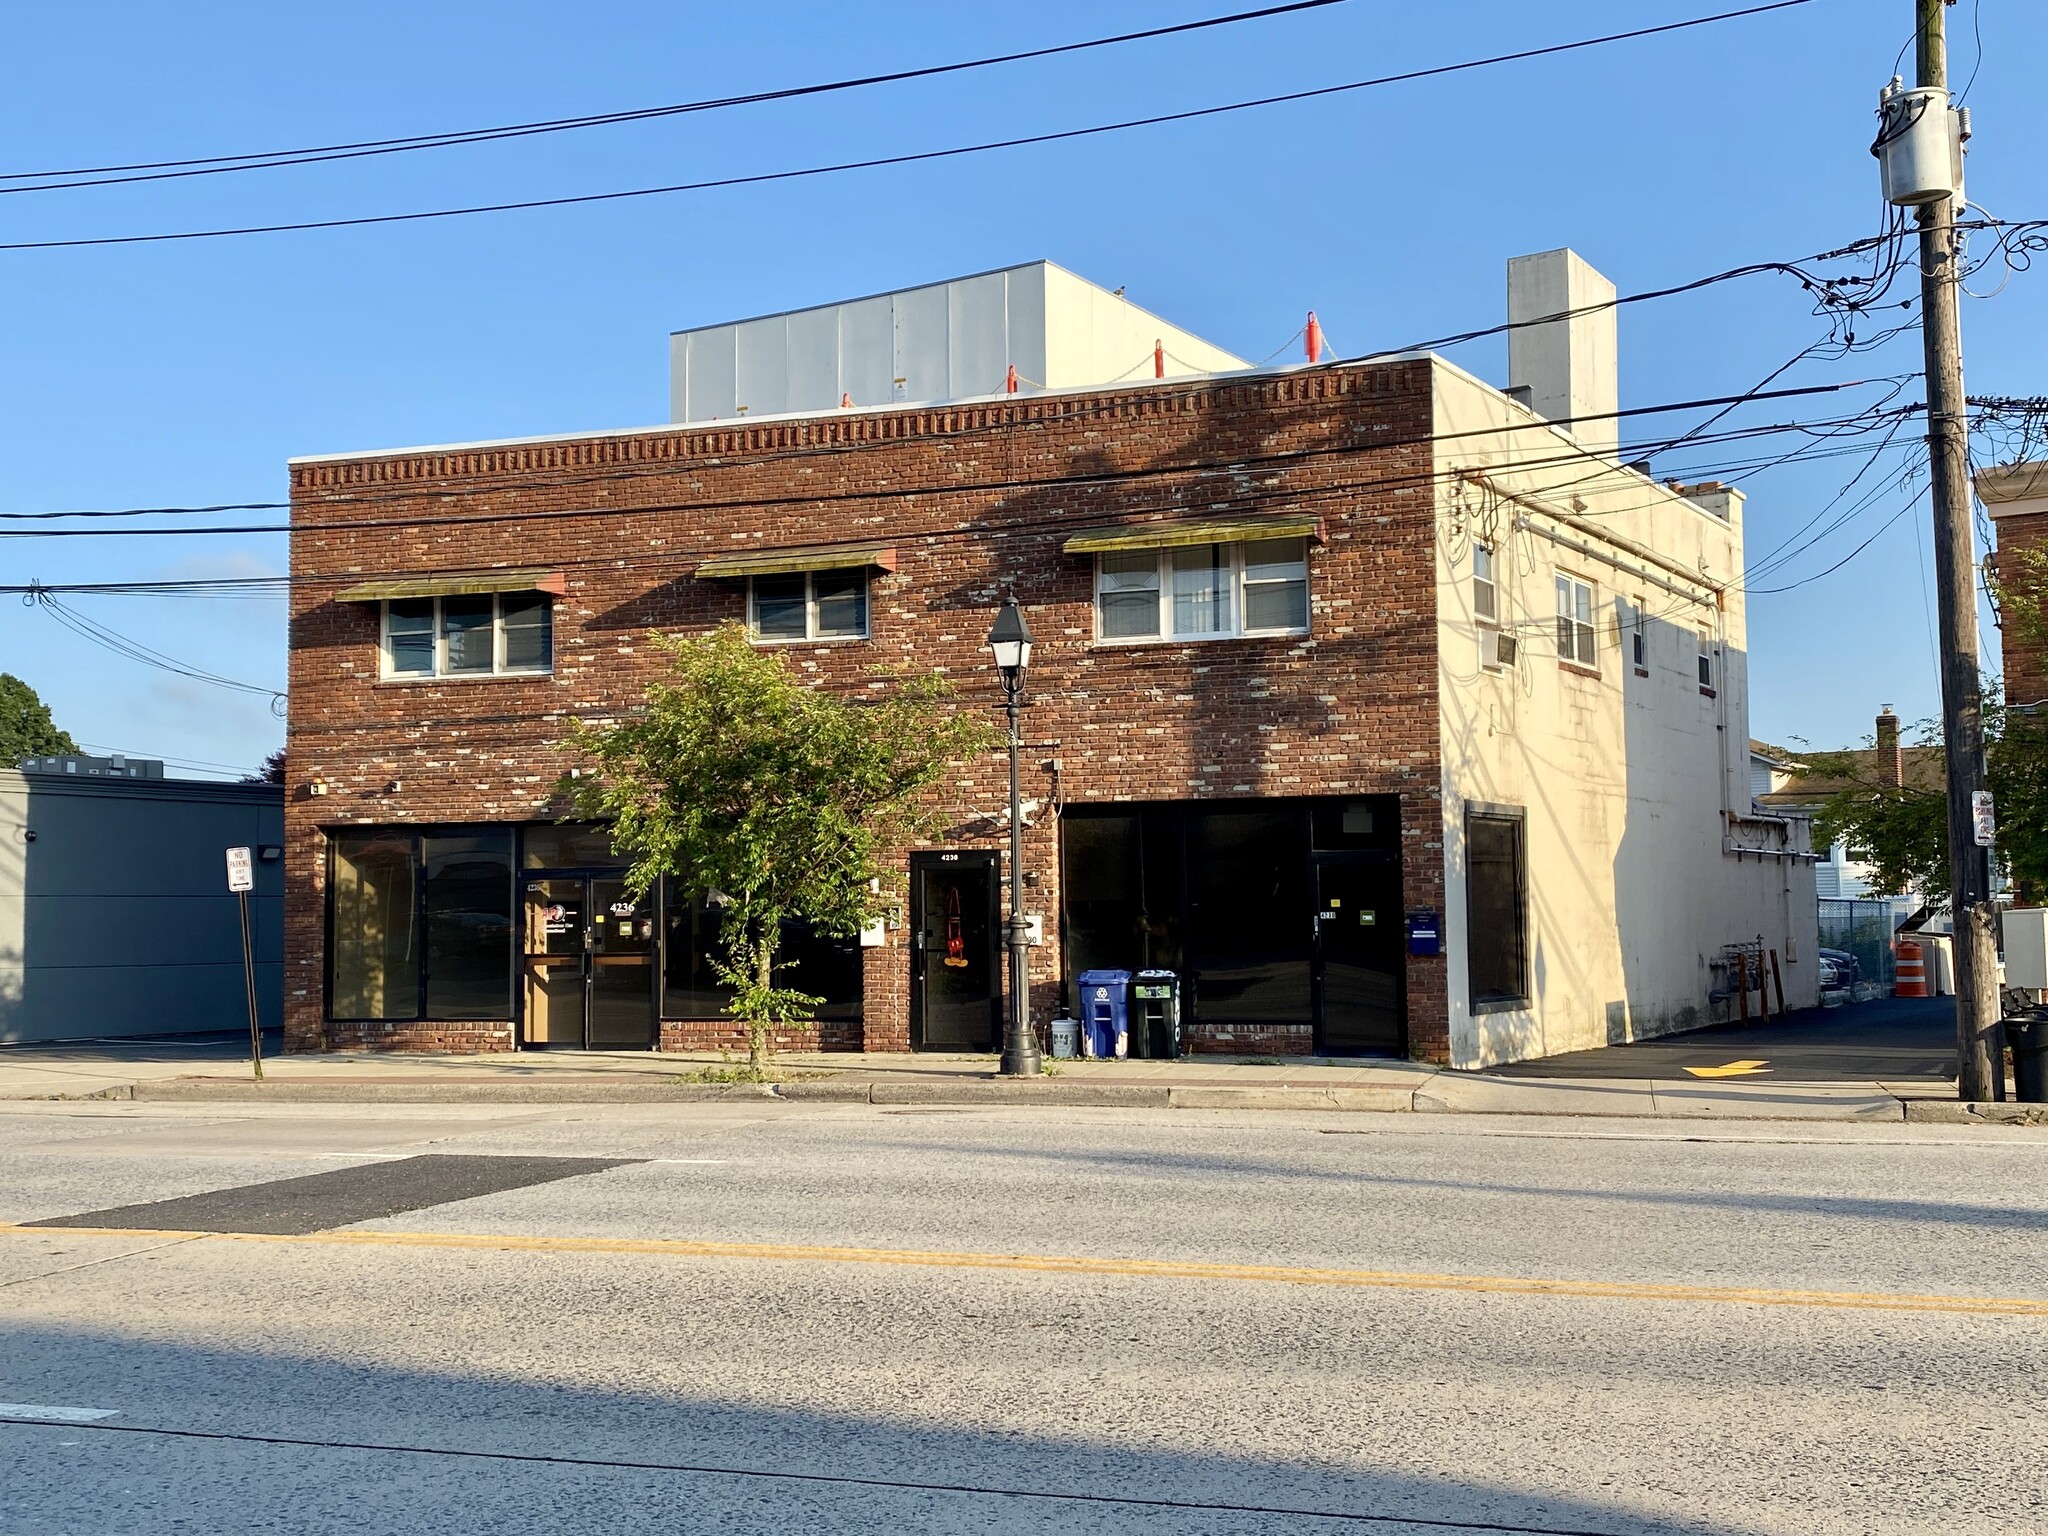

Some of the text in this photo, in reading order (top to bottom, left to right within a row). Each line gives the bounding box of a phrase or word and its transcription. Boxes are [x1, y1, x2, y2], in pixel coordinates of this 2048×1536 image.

[234, 851, 243, 859] NO
[230, 860, 249, 868] PARKING
[609, 902, 635, 913] 4236
